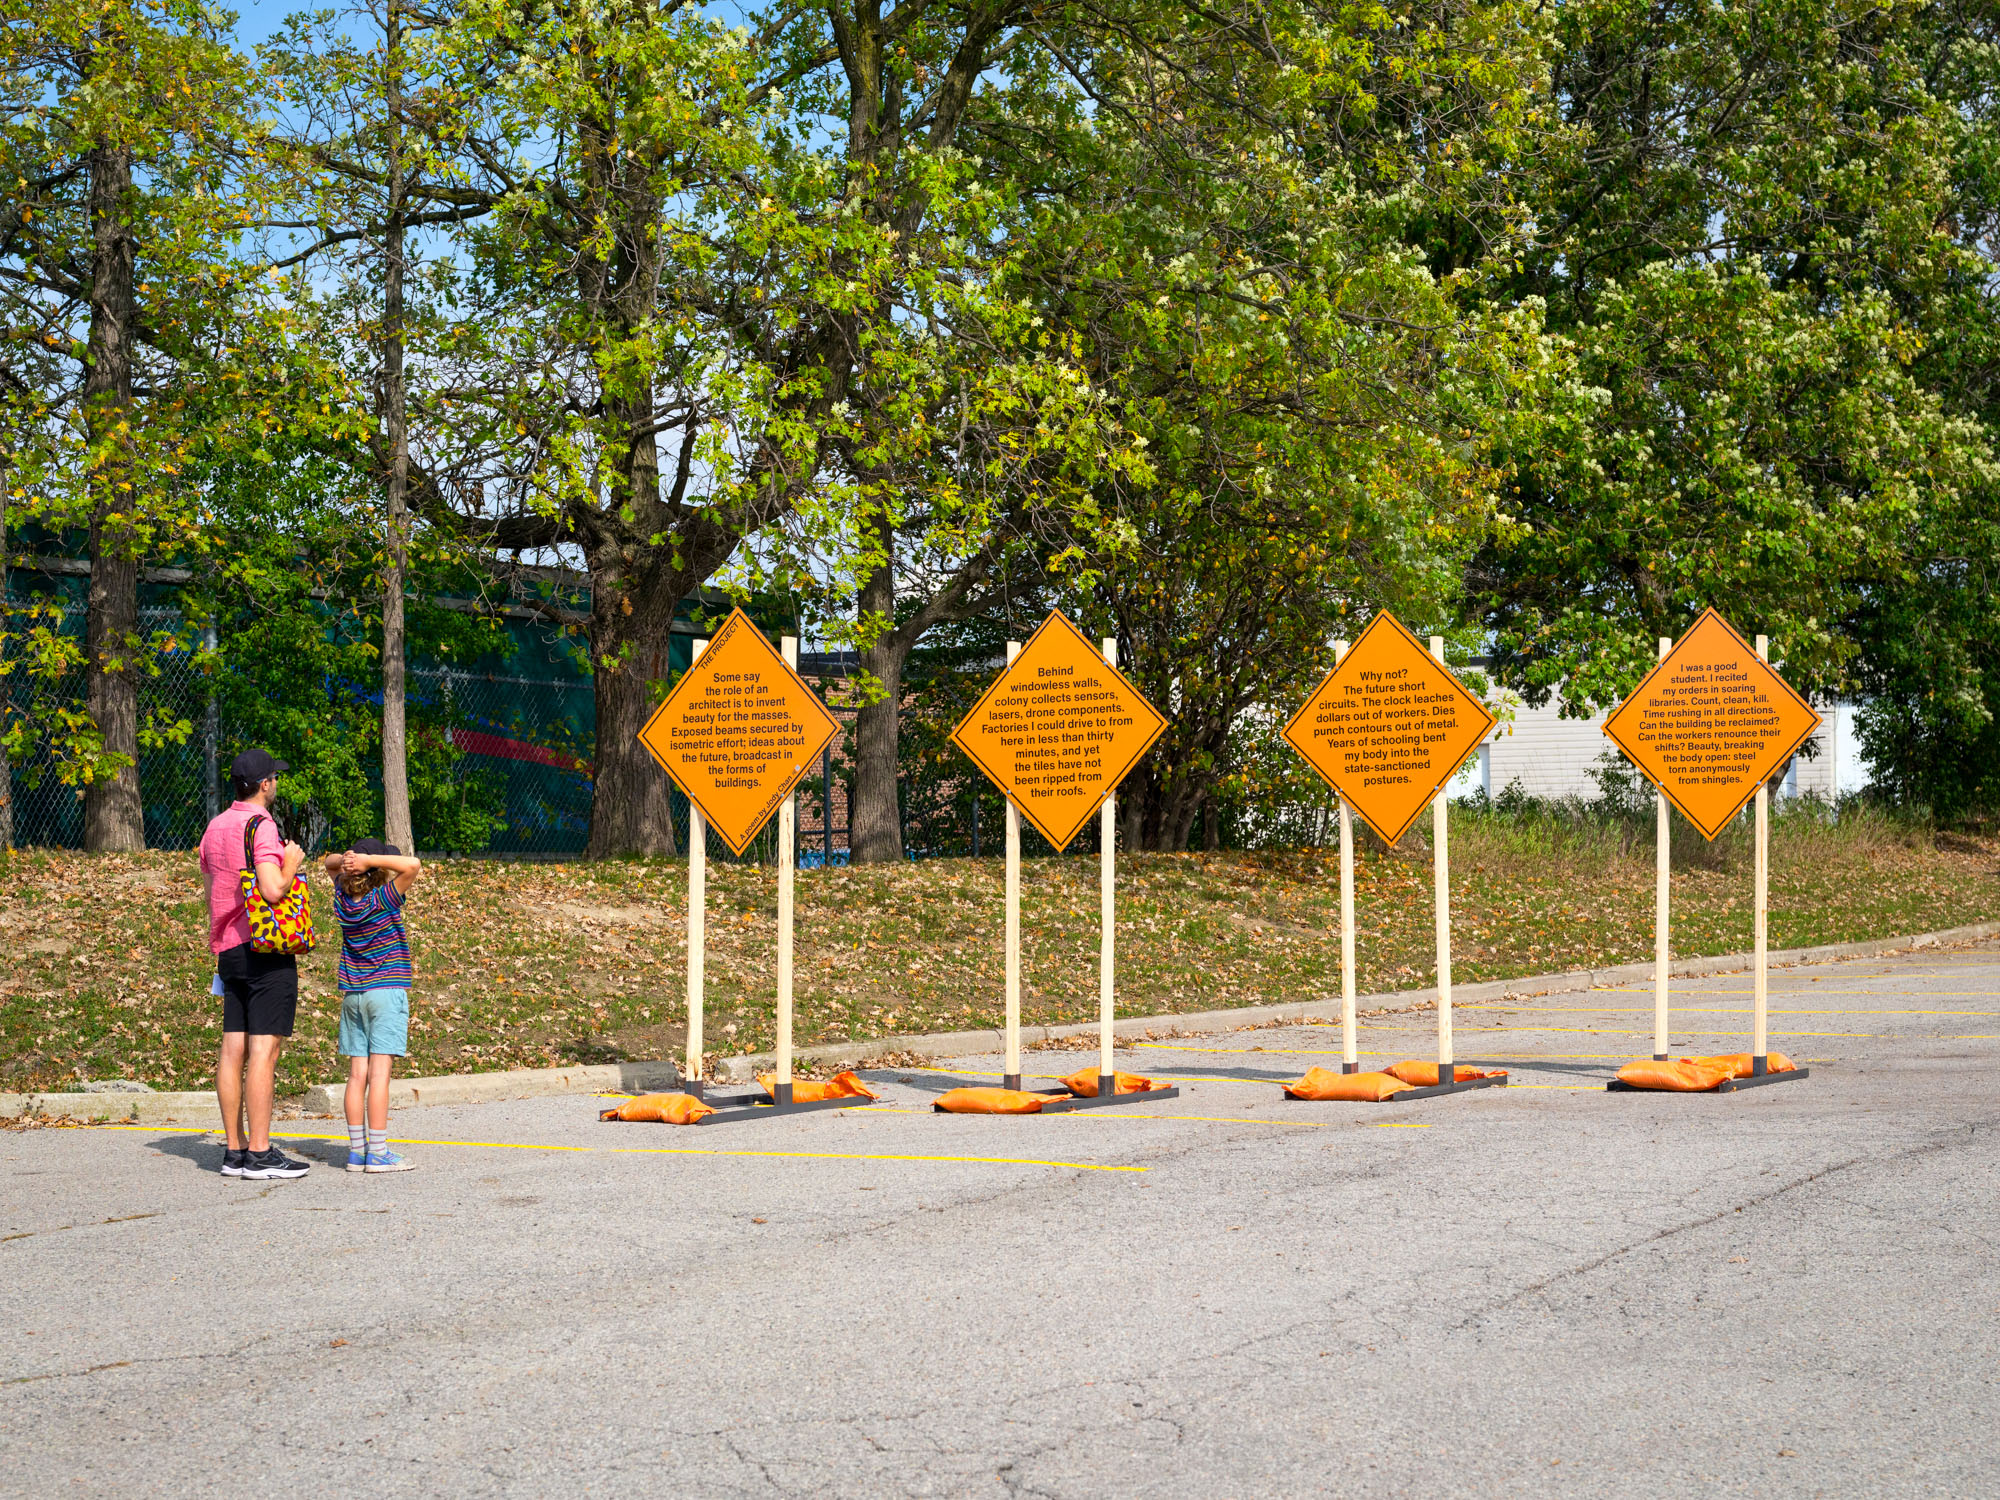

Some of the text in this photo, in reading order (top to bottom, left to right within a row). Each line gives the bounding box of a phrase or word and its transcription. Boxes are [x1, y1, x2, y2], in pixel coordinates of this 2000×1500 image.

[700, 621, 740, 670] THE PROJECT
[1038, 665, 1074, 677] Behind
[1681, 664, 1683, 672] I
[1714, 662, 1737, 673] good
[713, 672, 760, 683] Some say
[1359, 668, 1408, 683] Why not?
[1670, 672, 1748, 684] student. I recited
[705, 684, 768, 696] the role of an
[1010, 677, 1102, 692] windowless walls,
[1343, 681, 1426, 695] The future short
[1662, 684, 1756, 697] my orders in soaring
[689, 696, 786, 710] architect is to invent
[995, 692, 1118, 707] colony collects sensors,
[1319, 693, 1454, 710] circuits. The clock leaches
[1649, 694, 1769, 707] libraries. Count, clean, kill.
[683, 711, 791, 725] beauty for the masses.
[989, 703, 1125, 720] lasers, drone components.
[1316, 706, 1455, 723] dollars out of workers. Dies
[1643, 710, 1665, 718] Time
[1667, 708, 1701, 718] rushing
[1714, 707, 1725, 716] all
[1727, 706, 1776, 715] directions.
[982, 716, 1133, 734] Factories I could drive to from
[1314, 718, 1459, 739] punch contours out of metal.
[1639, 716, 1780, 730] Can the building be reclaimed?
[671, 722, 803, 739] Exposed beams secured by
[1638, 728, 1781, 741] Can the workers renounce their
[670, 736, 805, 750] isometric effort; ideas about
[1000, 731, 1114, 746] here in less than thirty
[1327, 732, 1446, 748] Years of schooling bent
[1016, 744, 1100, 759] minutes, and yet
[1654, 740, 1764, 752] shifts? Beauty, breaking
[682, 749, 793, 763] the future, broadcast in
[1344, 747, 1429, 762] my body into the
[1663, 751, 1756, 764] the body open: steel
[708, 763, 766, 775] the forms of
[1014, 758, 1101, 772] the tiles have not
[1344, 759, 1430, 774] state-sanctioned
[1668, 763, 1750, 775] torn anonymously
[715, 777, 761, 789] buildings.
[1015, 772, 1102, 785] been ripped from
[1364, 775, 1412, 788] postures.
[1678, 775, 1743, 786] from shingles.
[1030, 785, 1086, 798] their roofs.
[739, 775, 793, 841] A poem by Jody Chan
